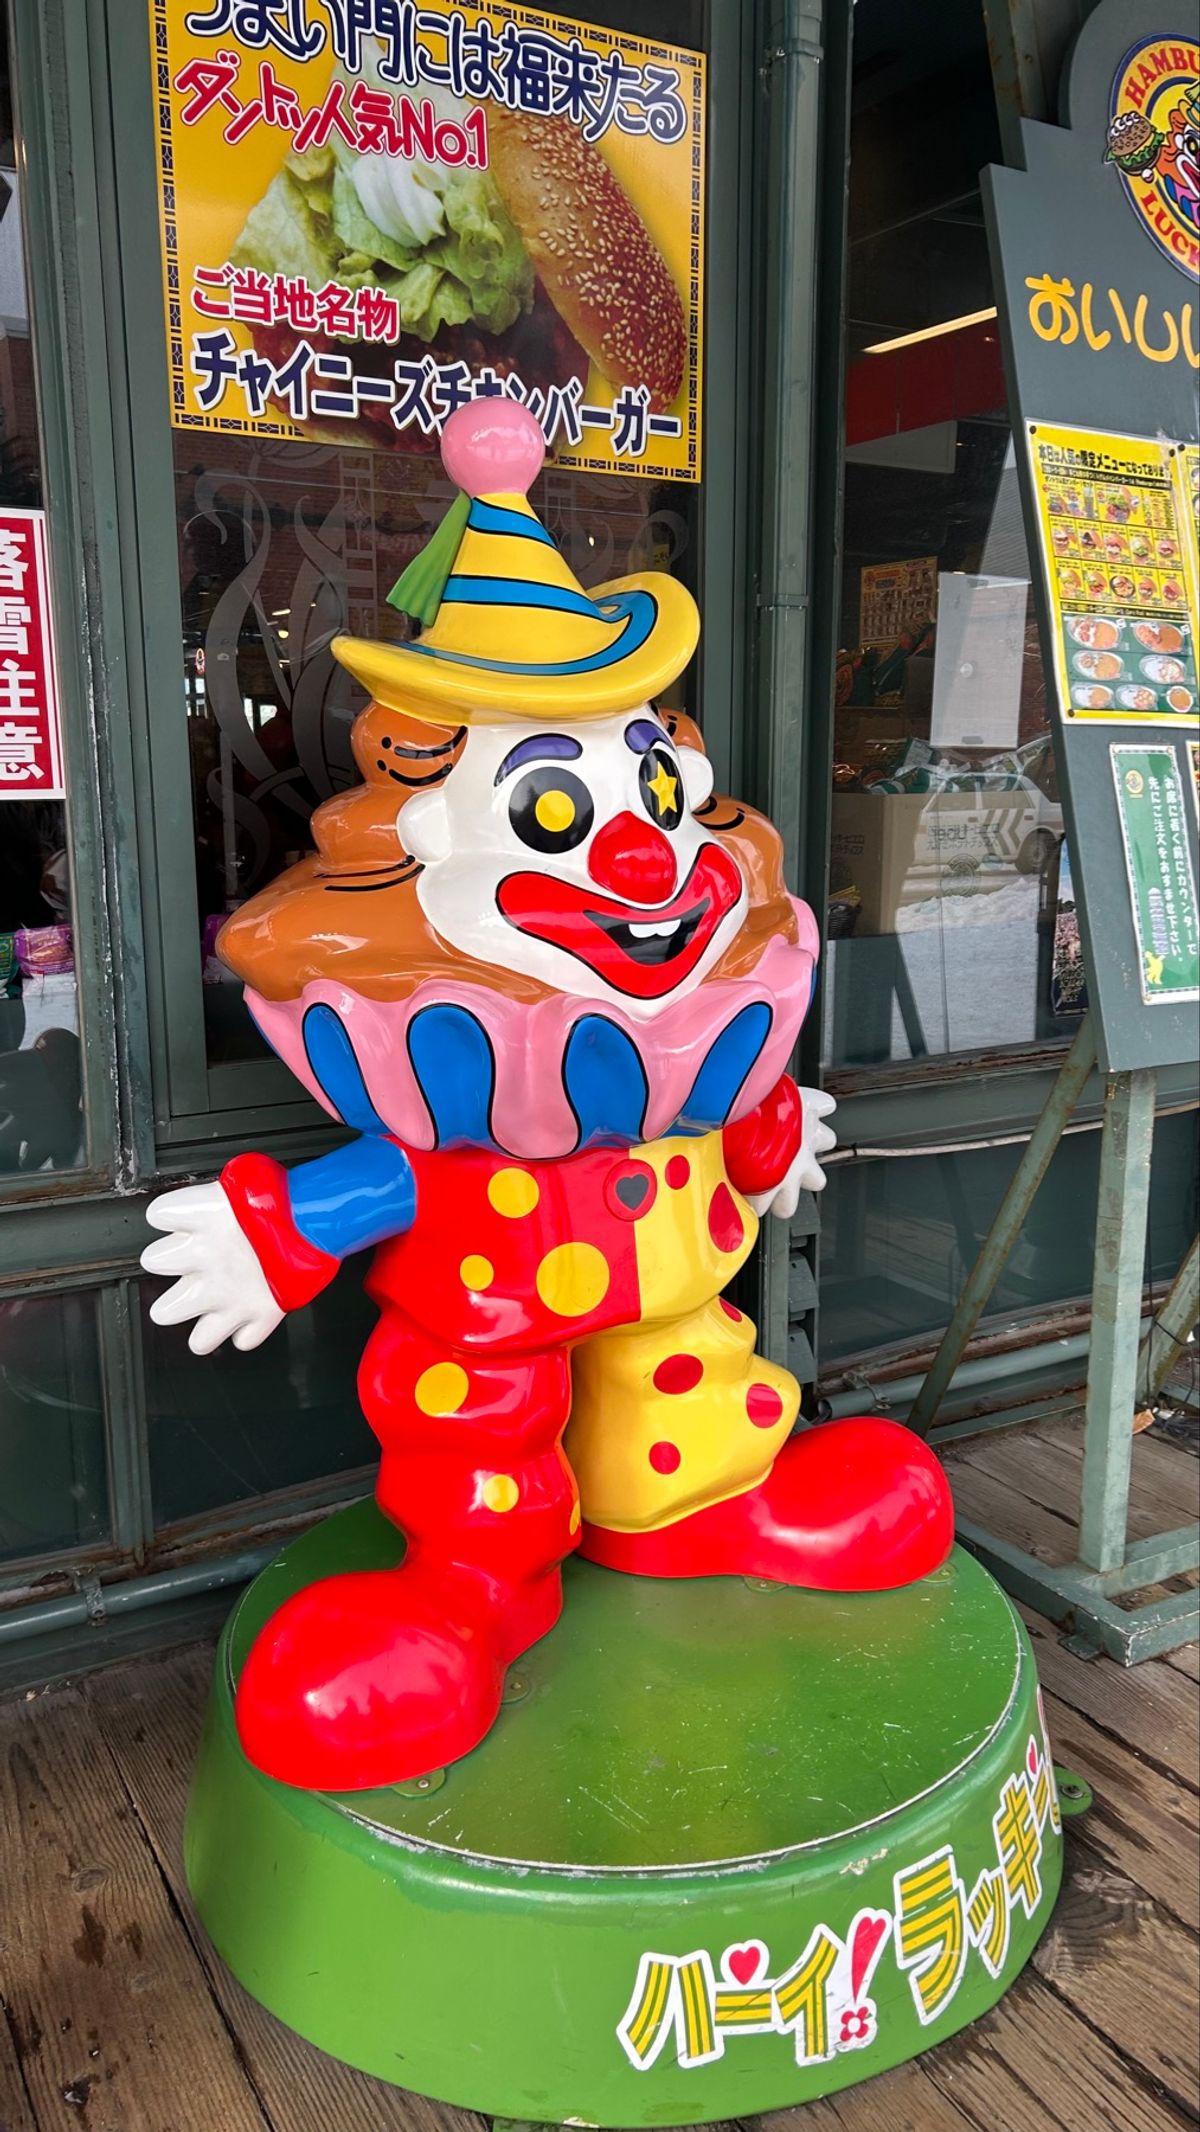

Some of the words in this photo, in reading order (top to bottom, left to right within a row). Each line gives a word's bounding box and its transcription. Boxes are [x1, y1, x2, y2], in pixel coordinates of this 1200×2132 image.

[191, 265, 400, 343] ご当地名物
